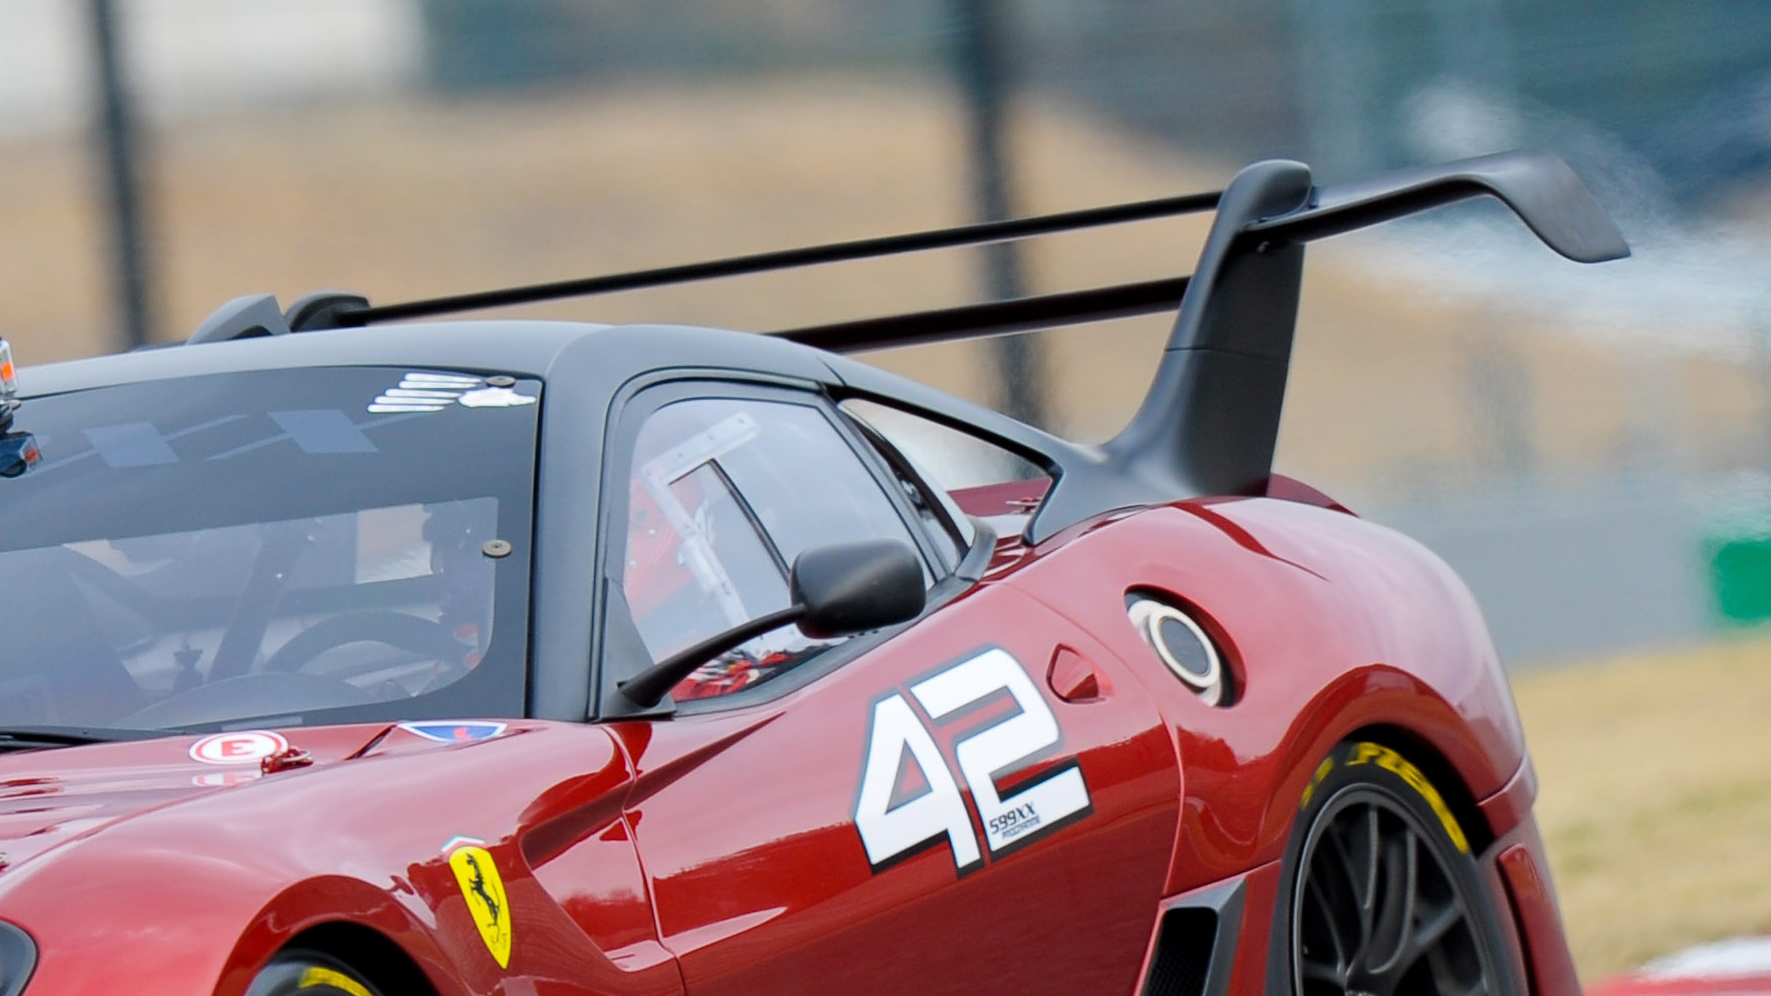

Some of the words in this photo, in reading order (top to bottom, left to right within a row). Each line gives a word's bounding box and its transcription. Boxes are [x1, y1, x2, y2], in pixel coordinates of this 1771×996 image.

[222, 740, 255, 756] E
[853, 645, 1092, 873] 42
[988, 800, 1037, 836] 599XX
